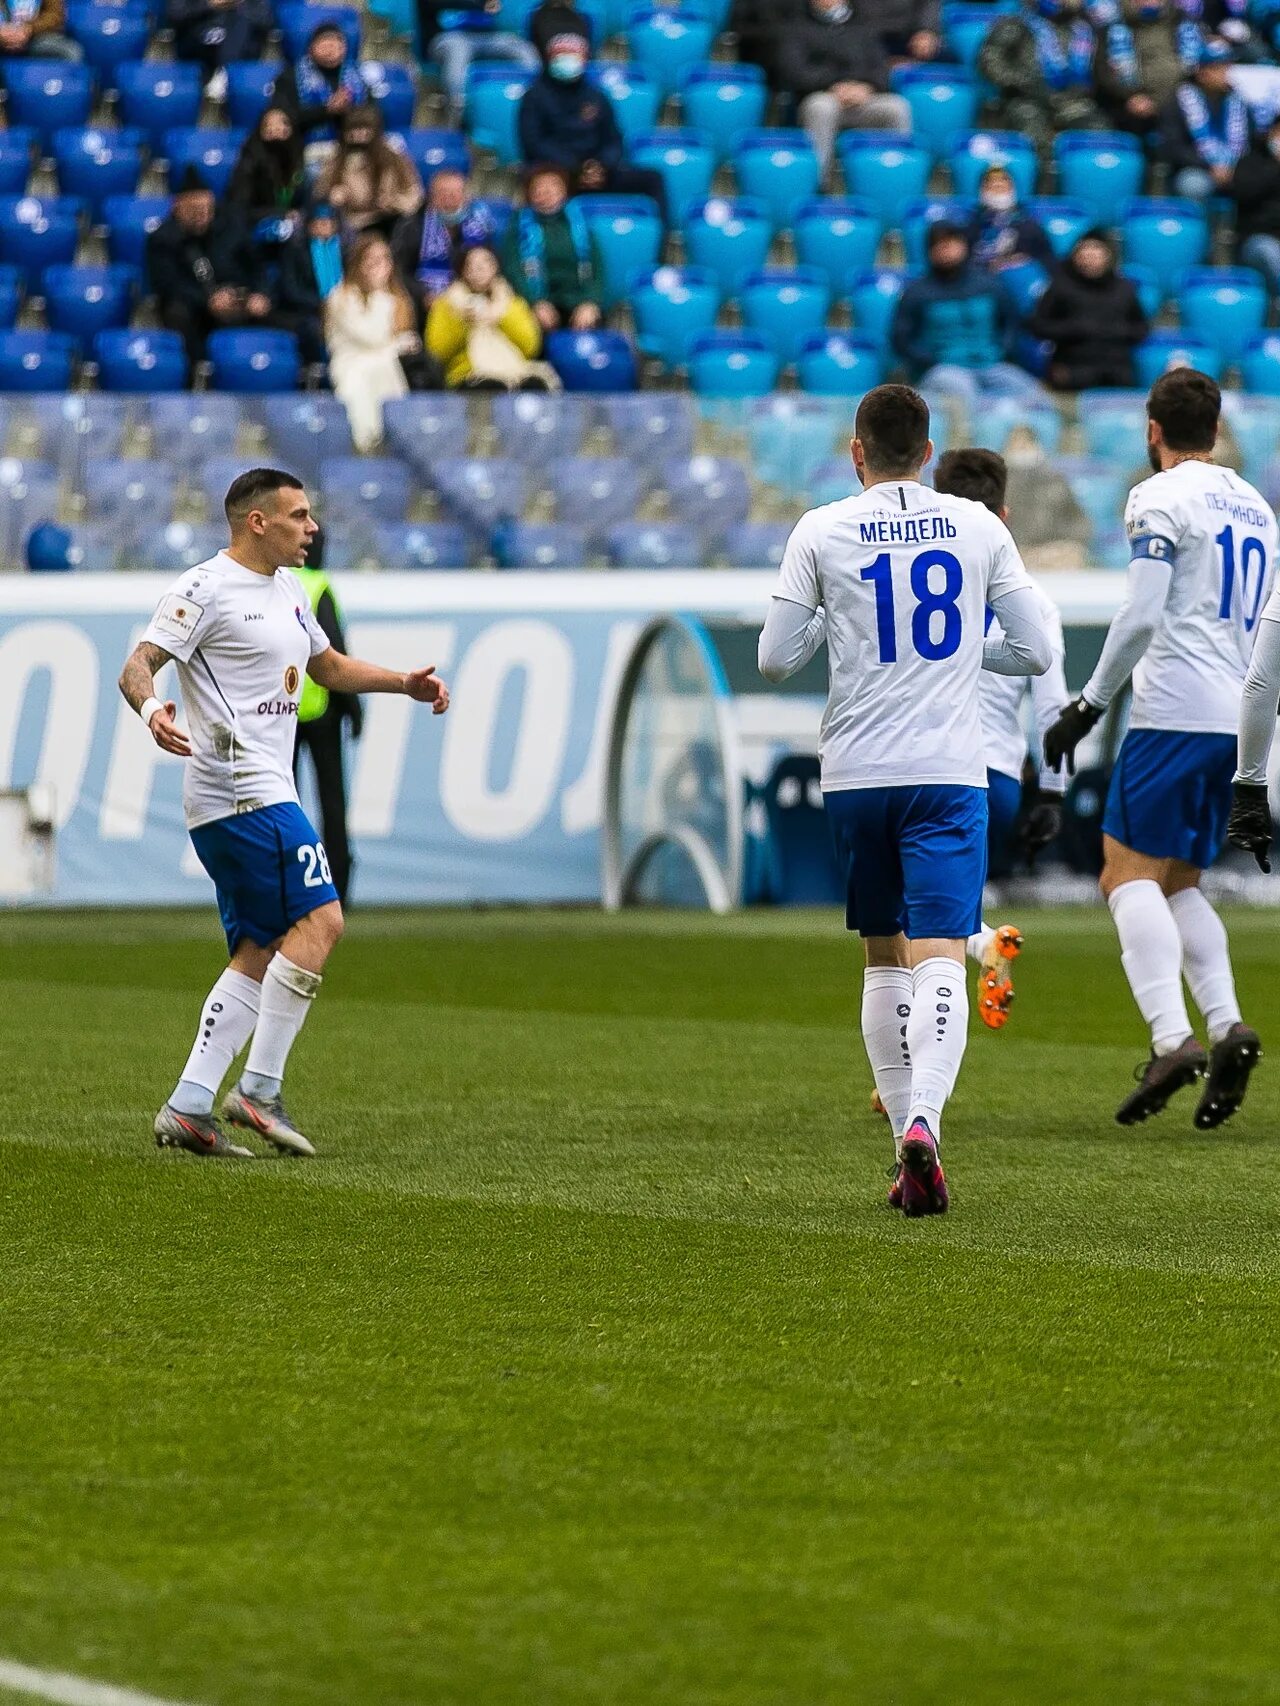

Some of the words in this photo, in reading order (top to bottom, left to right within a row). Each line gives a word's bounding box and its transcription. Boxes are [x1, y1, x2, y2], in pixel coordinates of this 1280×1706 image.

[859, 517, 957, 543] МЕНДЕЛЬ
[859, 549, 963, 663] 18
[1215, 523, 1267, 633] 10
[297, 841, 333, 888] 28
